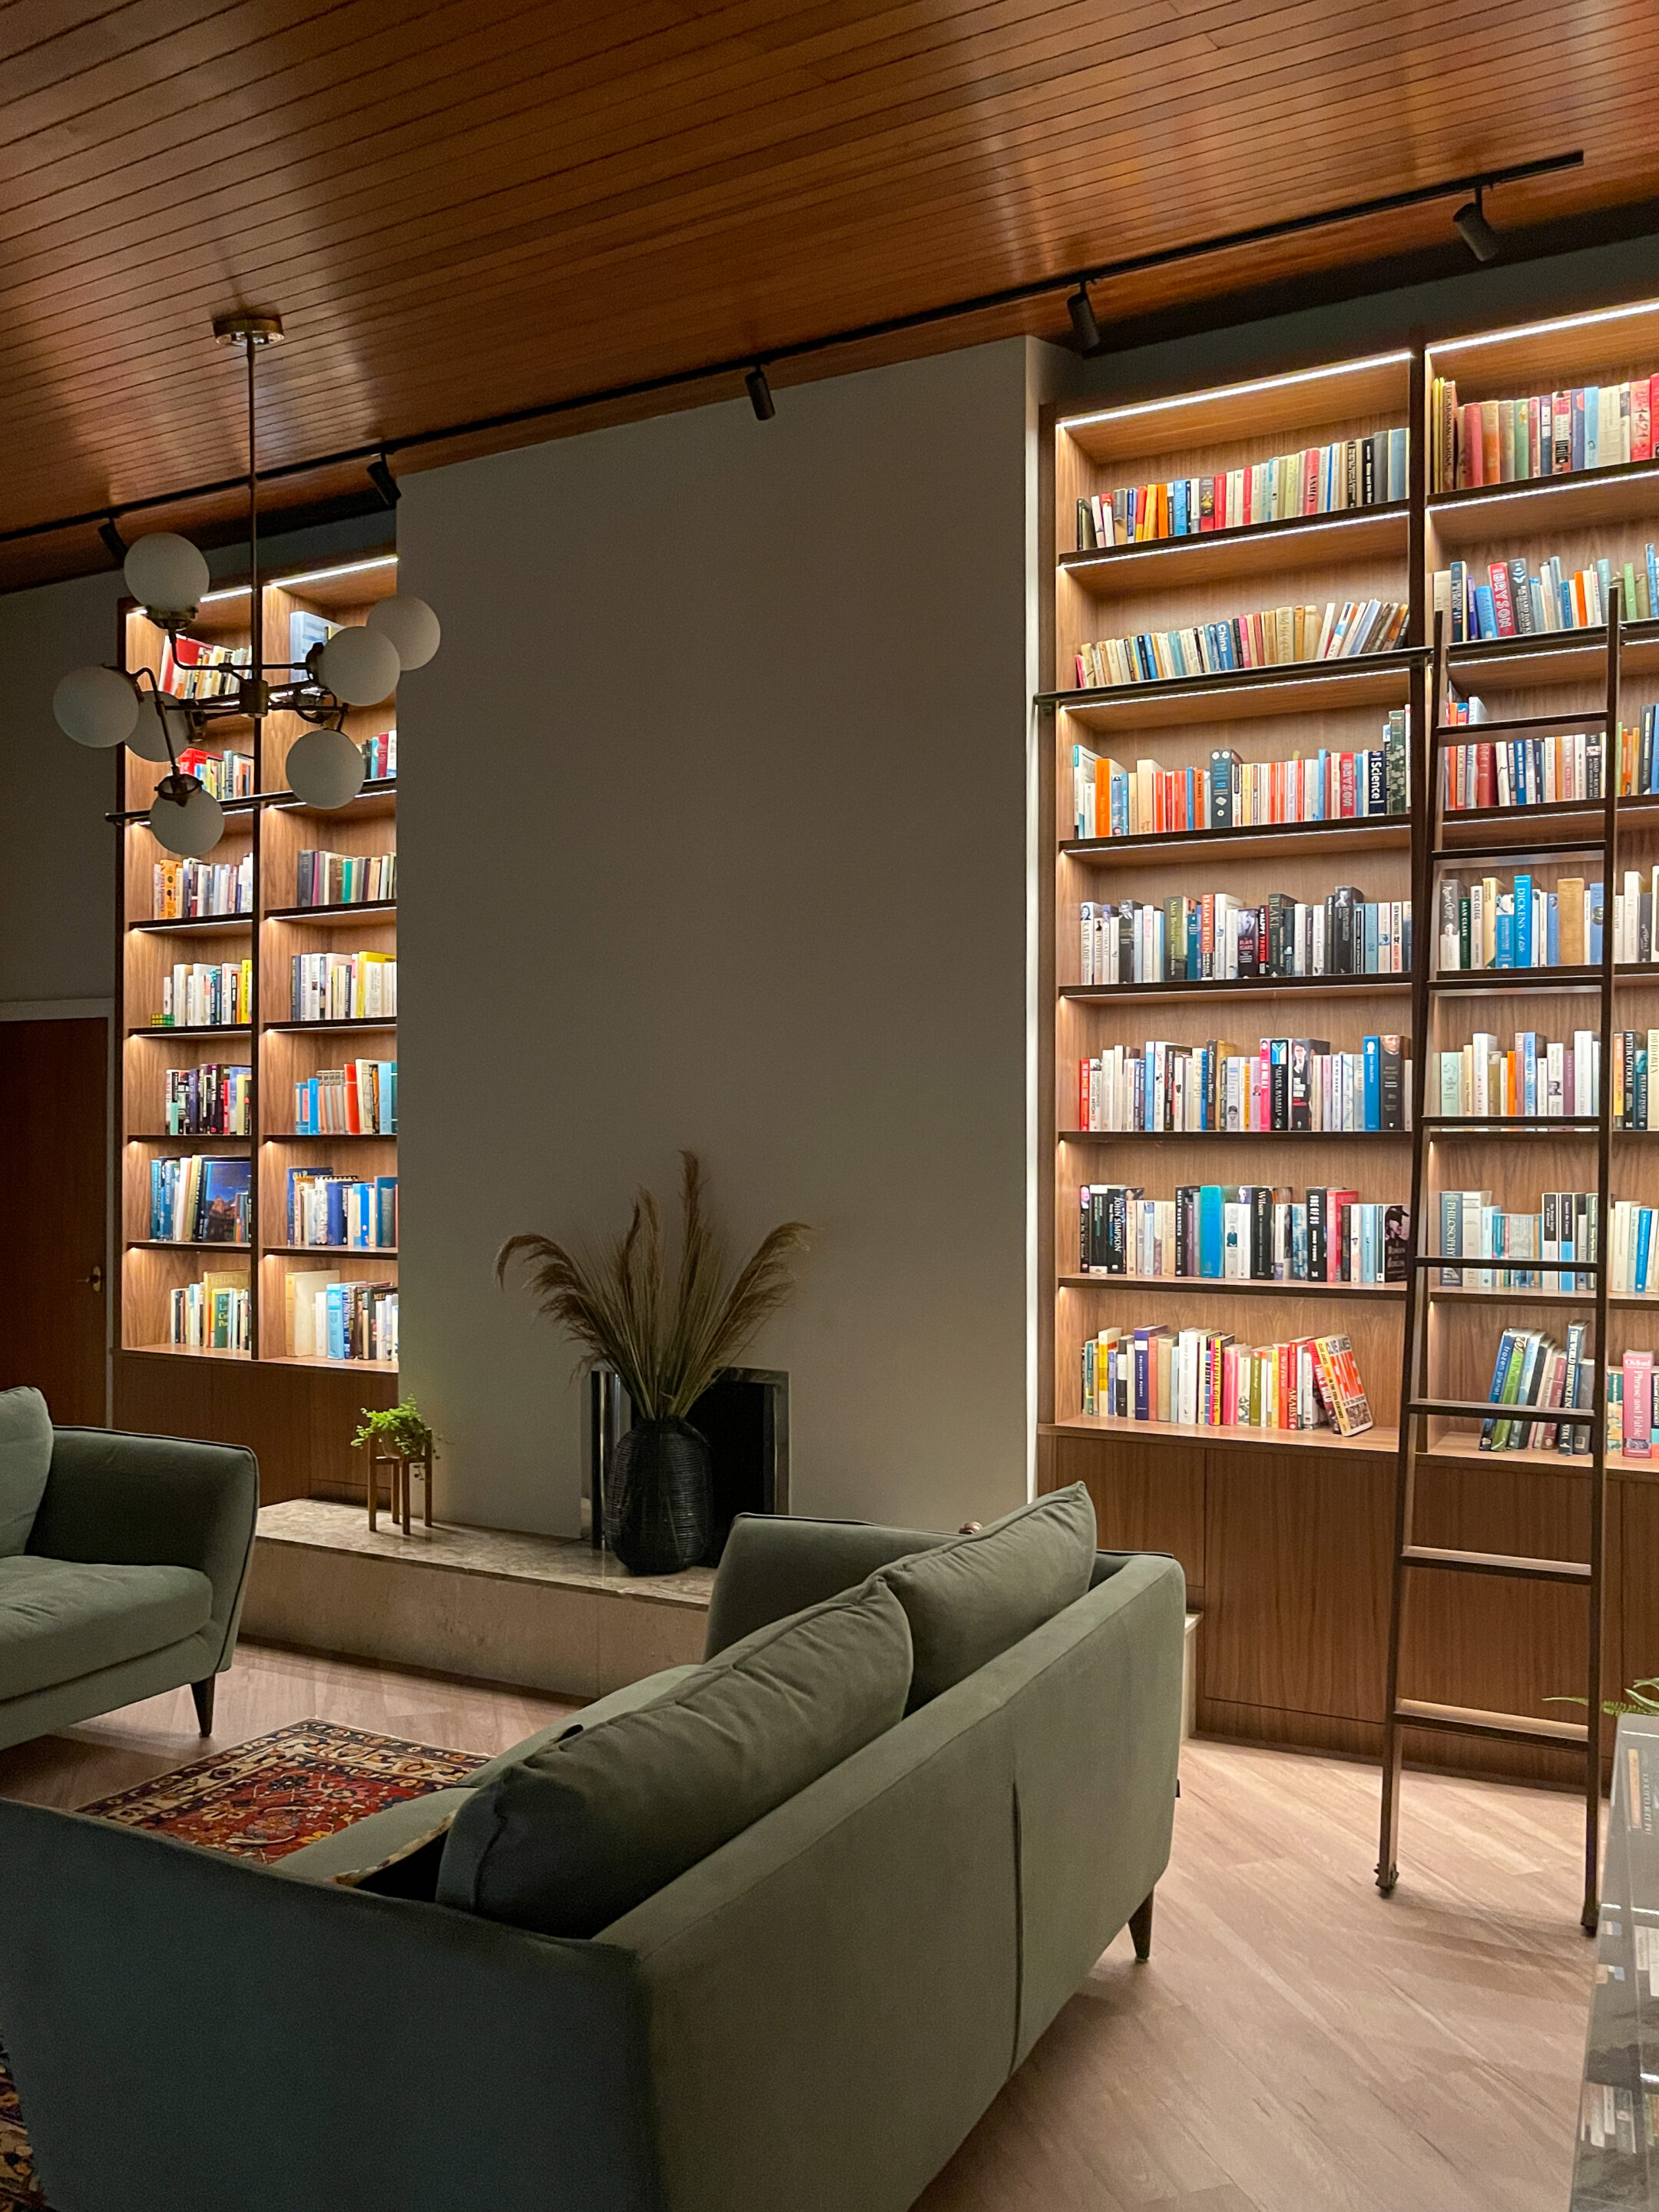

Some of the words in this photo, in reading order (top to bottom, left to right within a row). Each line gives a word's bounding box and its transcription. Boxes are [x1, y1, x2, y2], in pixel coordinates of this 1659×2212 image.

[1492, 573, 1512, 628] BRYSON
[1519, 585, 1528, 613] RICHARD
[1218, 624, 1227, 651] China
[1371, 762, 1381, 799] Science
[1270, 897, 1279, 929] BLAKE
[1517, 888, 1525, 929] DICKENS
[1625, 1034, 1634, 1056] PETER
[1625, 1057, 1634, 1088] O'TOOLE
[1447, 1202, 1456, 1255] PHILOSOPHY
[1499, 1346, 1510, 1370] frozen
[1568, 1343, 1577, 1364] WORLD
[1315, 1364, 1327, 1385] FOOL'S
[1321, 1386, 1333, 1402] GOLD
[1493, 1372, 1503, 1395] planet
[1565, 1364, 1575, 1396] REFERENCE
[1634, 1370, 1644, 1396] Phrase
[1335, 1401, 1344, 1419] CENTURY
[1634, 1399, 1644, 1413] and
[1634, 1416, 1644, 1436] Fable
